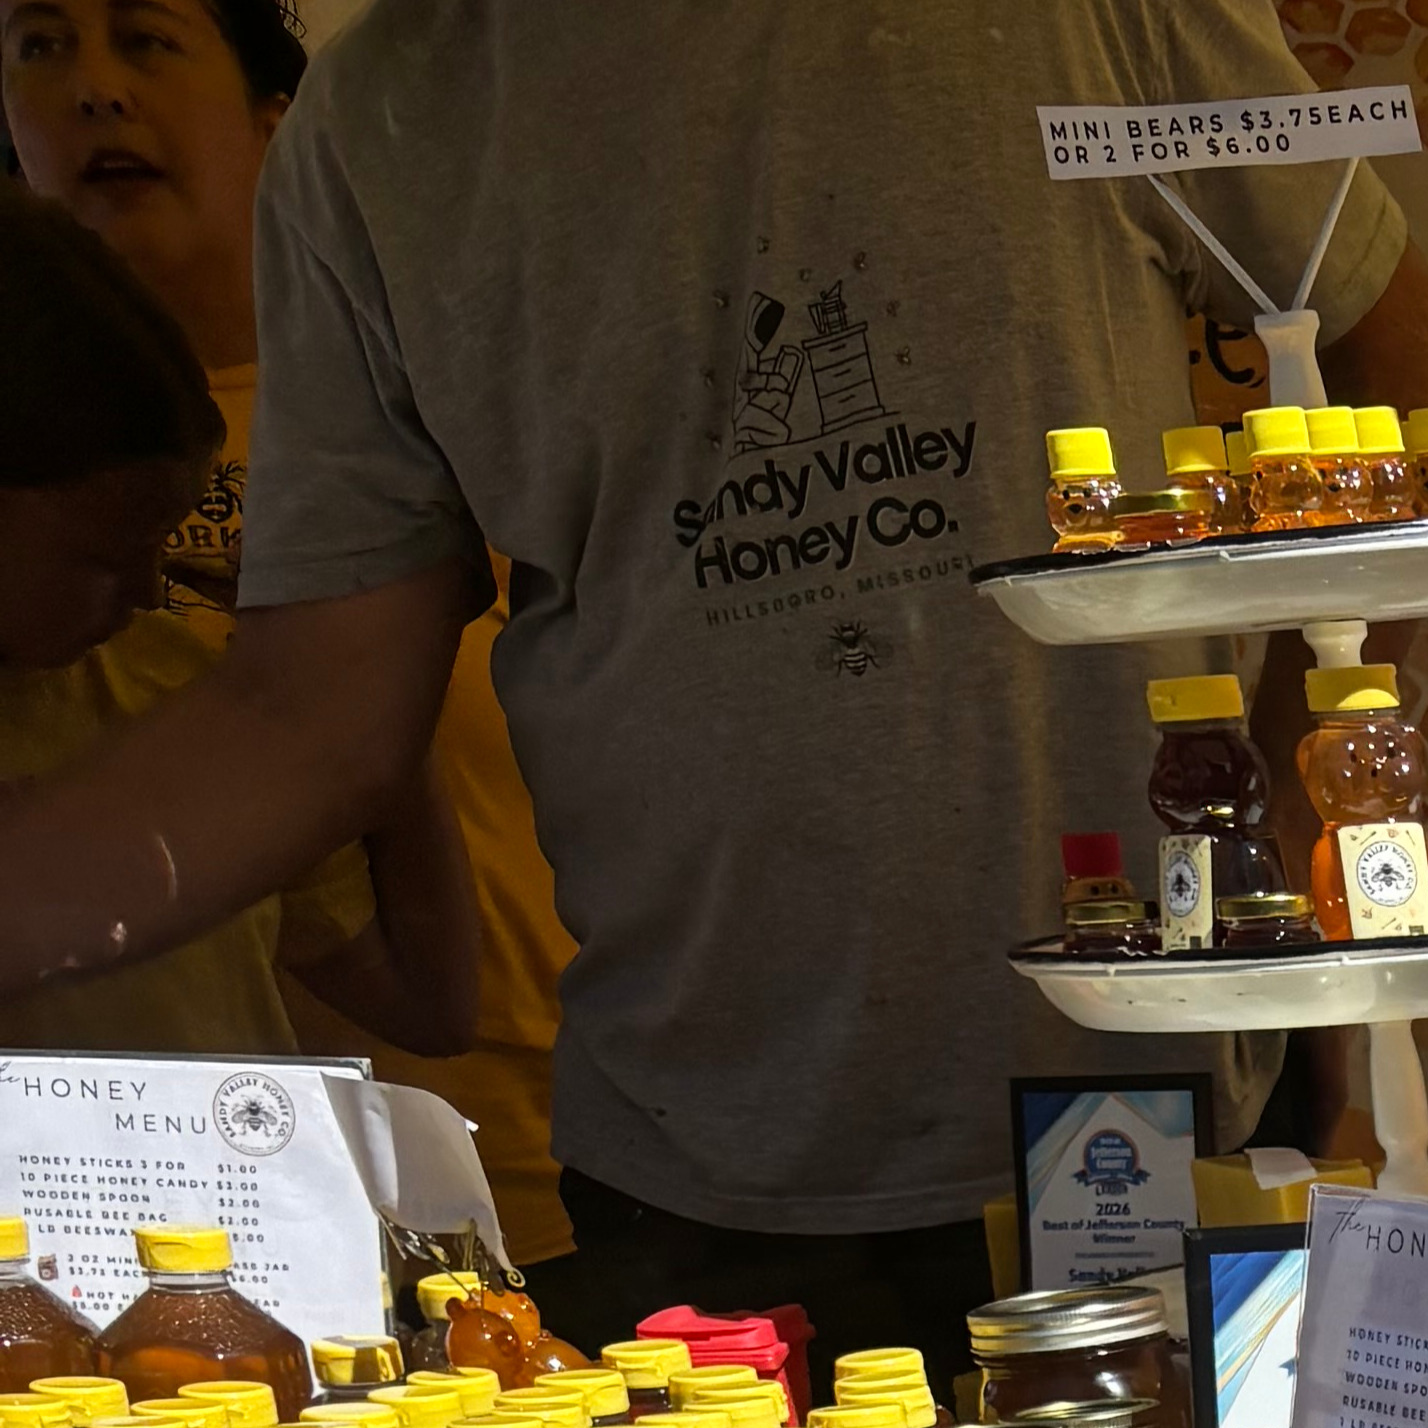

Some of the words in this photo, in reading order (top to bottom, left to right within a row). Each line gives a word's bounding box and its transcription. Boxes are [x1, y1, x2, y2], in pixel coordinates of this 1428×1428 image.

[1050, 121, 1111, 141] MINI
[1127, 114, 1223, 138] BEARS
[1054, 146, 1090, 164] OR
[1106, 145, 1117, 163] 2
[1132, 141, 1190, 162] FOR
[1207, 136, 1290, 157] $6.00
[814, 421, 976, 491] Valley
[695, 516, 858, 588] Honey
[867, 497, 959, 546] Co.
[24, 1077, 146, 1100] HONEY
[115, 1114, 207, 1134] MENU
[19, 1155, 70, 1166] HONEY
[80, 1157, 133, 1168] STICKS
[44, 1173, 88, 1184] PIECE
[97, 1175, 148, 1187] HONEY
[156, 1178, 208, 1190] CANDY
[23, 1189, 91, 1201] WOODEN
[138, 1212, 168, 1223] BAG
[1042, 1220, 1068, 1230] Best
[1071, 1219, 1083, 1230] of
[1349, 1327, 1391, 1343] HONEY
[1366, 1353, 1400, 1370] PIECE
[1345, 1371, 1398, 1391] WOODEN
[1402, 1406, 1426, 1421] BEE
